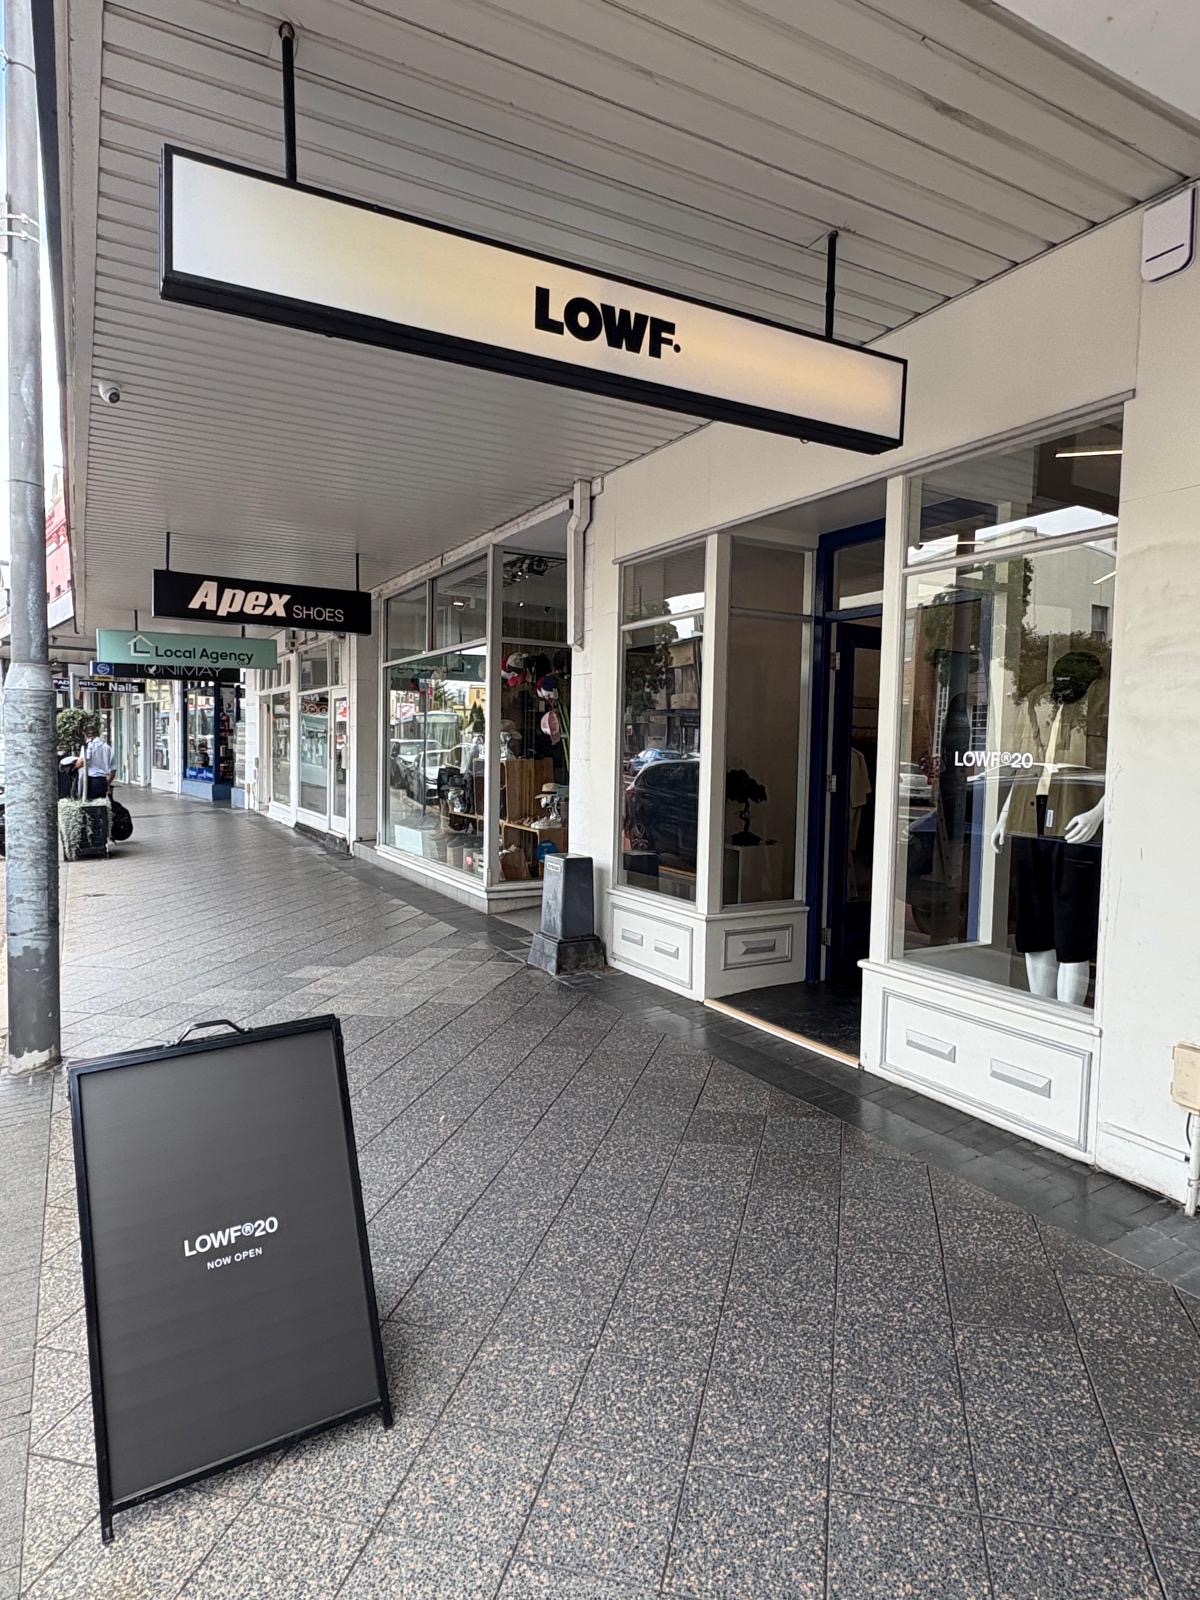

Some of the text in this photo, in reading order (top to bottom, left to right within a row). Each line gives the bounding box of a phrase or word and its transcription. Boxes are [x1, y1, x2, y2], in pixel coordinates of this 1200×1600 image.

[188, 580, 344, 623] Apex SHOES
[155, 645, 254, 666] Local Agency
[108, 682, 139, 692] Nails
[206, 1247, 263, 1270] NOW OPEN
